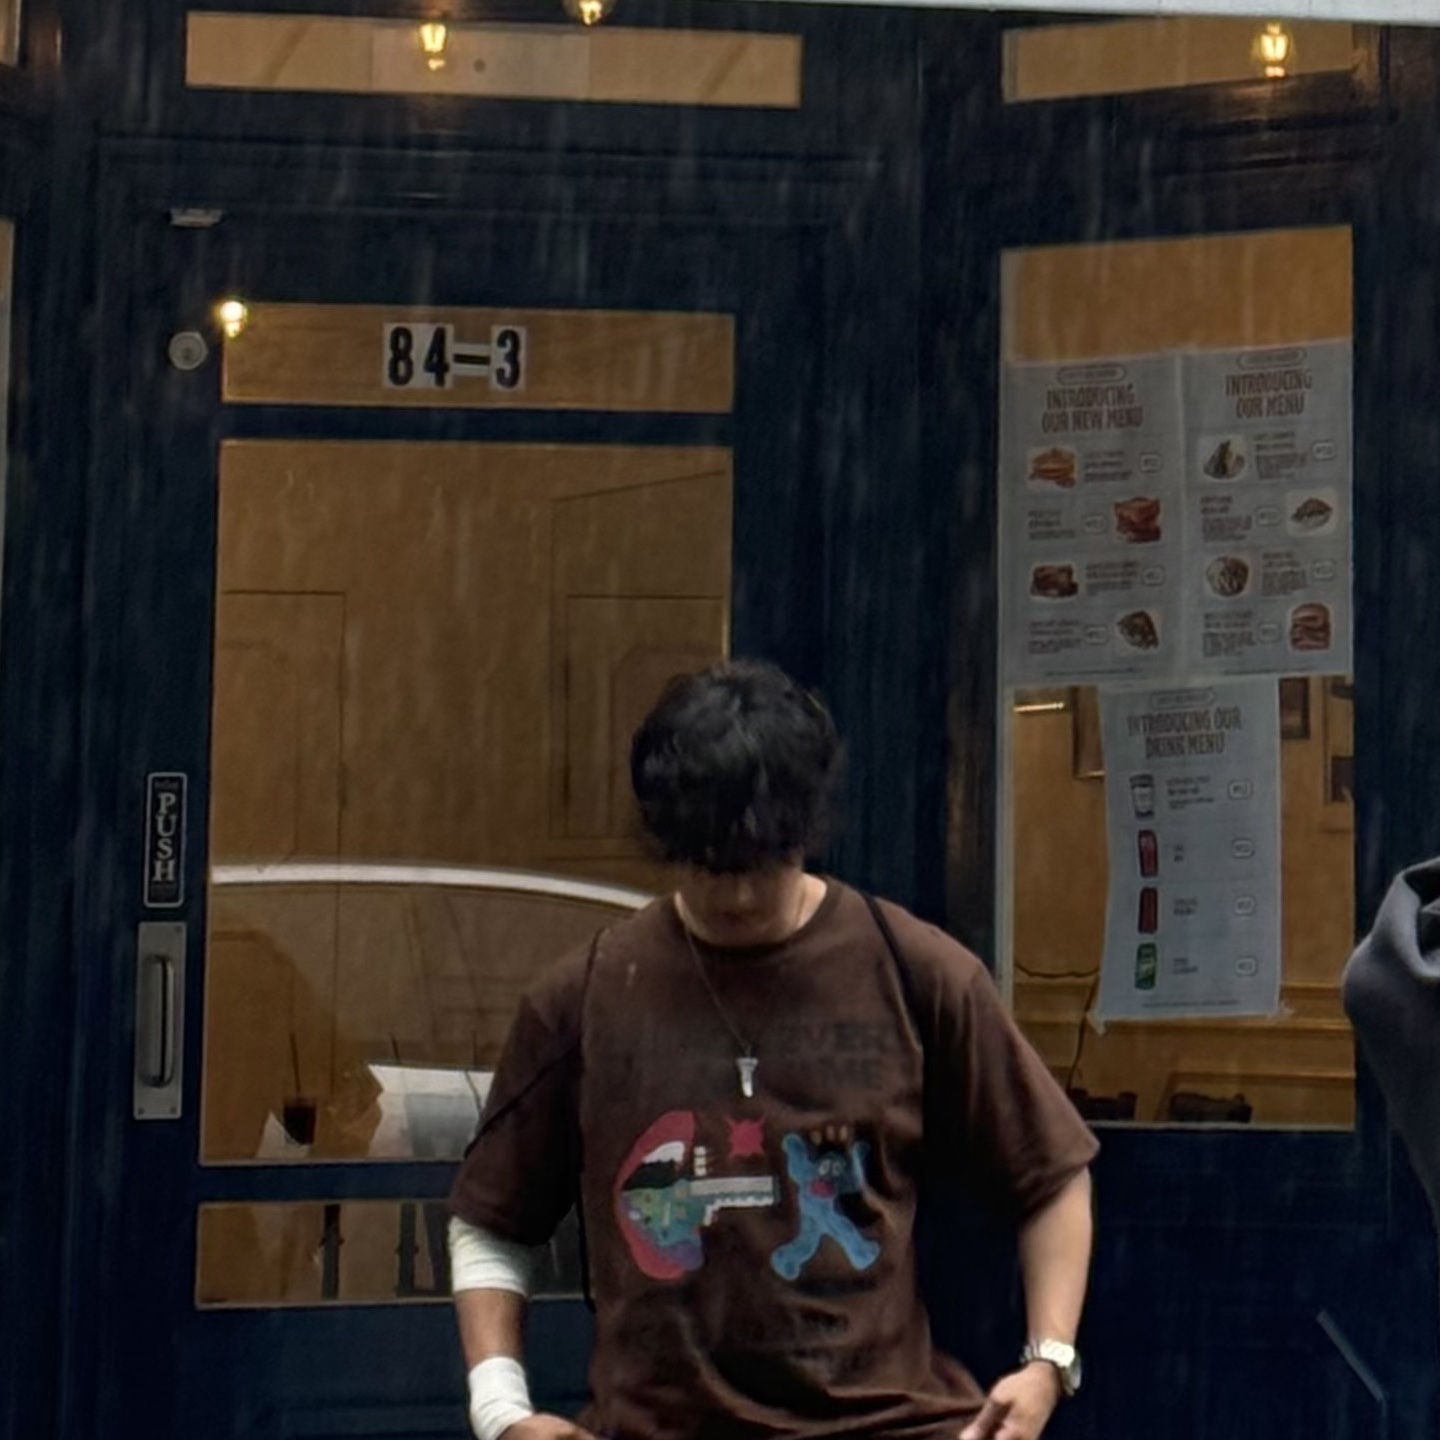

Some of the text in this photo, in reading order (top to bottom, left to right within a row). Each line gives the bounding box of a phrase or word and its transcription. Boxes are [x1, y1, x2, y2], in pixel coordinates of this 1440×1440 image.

[387, 326, 522, 388] 84-3
[1226, 369, 1312, 396] INTRODUCING
[1047, 384, 1135, 410] INTRODUCING
[1236, 393, 1304, 418] OUR MENU
[1043, 406, 1143, 433] OUR NEW MENU
[1128, 706, 1241, 735] INTRODUCING OUR
[1188, 733, 1224, 754] MENU
[151, 791, 178, 882] PUSH
